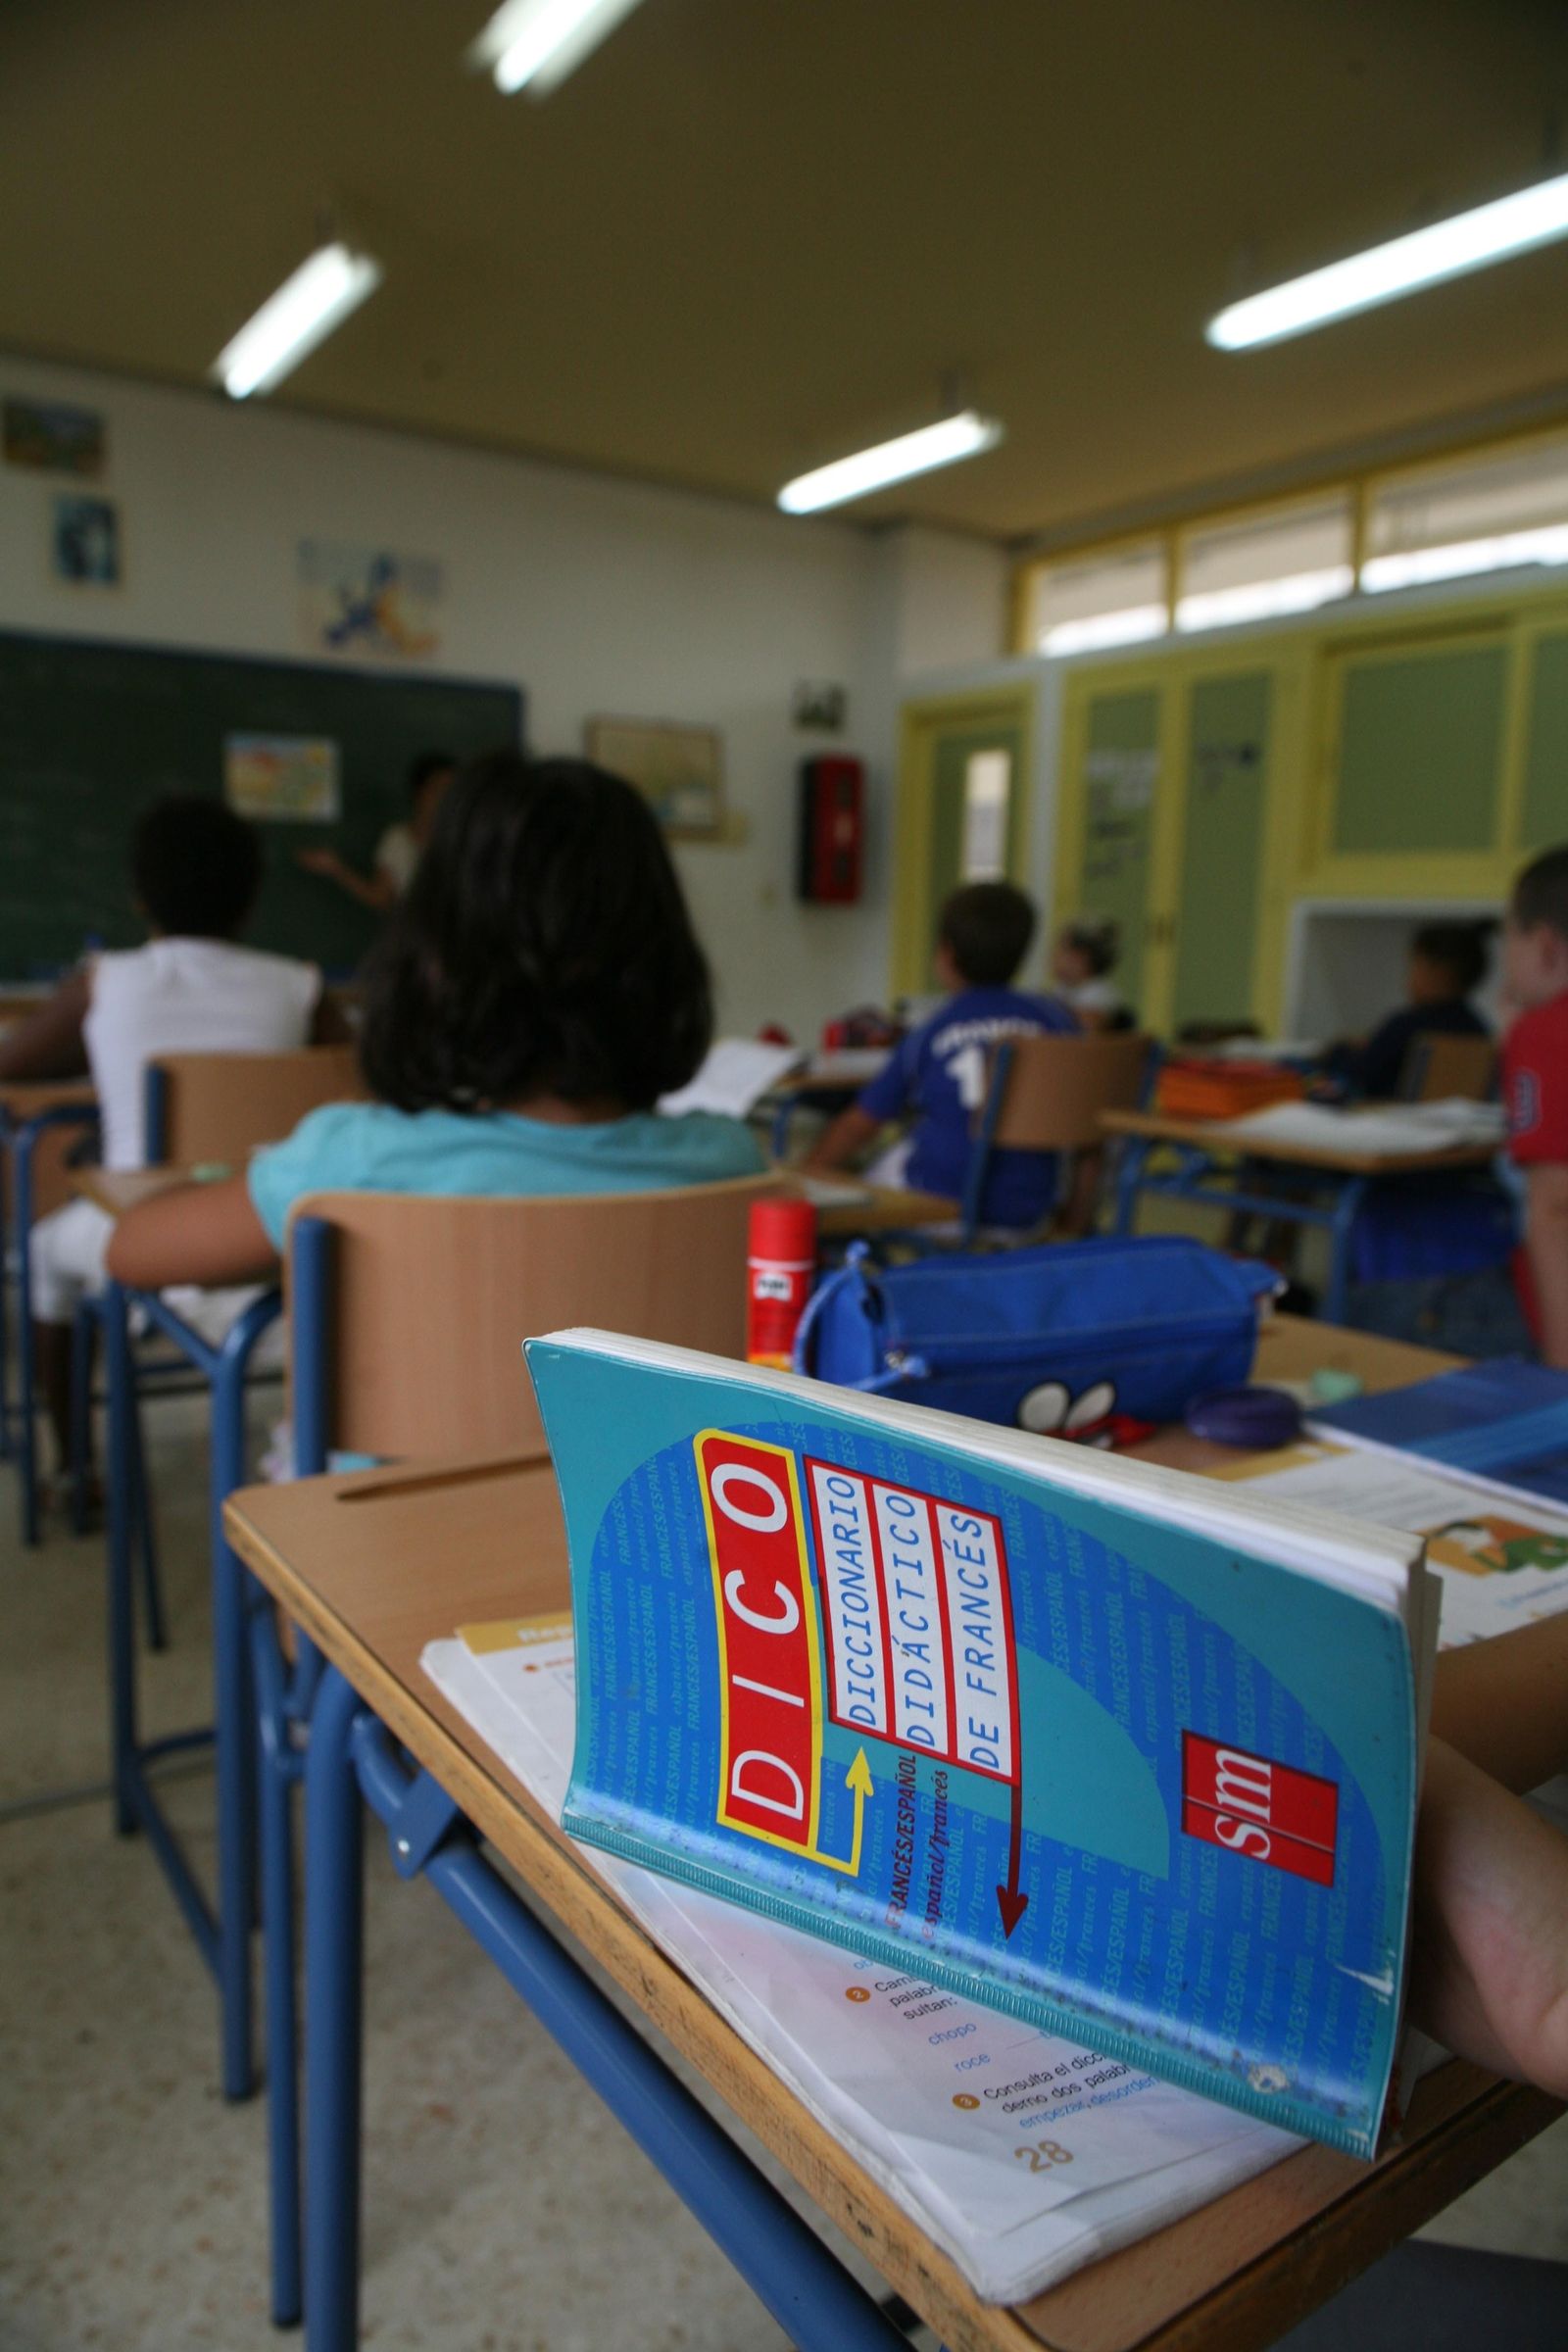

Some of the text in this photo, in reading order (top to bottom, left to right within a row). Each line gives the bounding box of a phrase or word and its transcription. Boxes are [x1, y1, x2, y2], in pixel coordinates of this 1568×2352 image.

[709, 1462, 806, 1823] DICO
[826, 1475, 878, 1727] DICCIONARIO
[884, 1494, 937, 1749] DIDÁCTICO
[948, 1513, 1003, 1772] DE FRANCÉS
[883, 1754, 917, 1929] FRANCÉS/ESPAÑOL
[921, 1769, 951, 1941] español/francés
[1212, 1747, 1273, 1861] sm
[903, 1997, 958, 2021] sultan:
[927, 2021, 977, 2047] chopo
[953, 2052, 992, 2074] roce
[983, 2070, 1054, 2101] Consulta
[1054, 2060, 1072, 2079] el
[1002, 2092, 1048, 2115] derno
[1051, 2080, 1082, 2101] dos
[1014, 2139, 1075, 2173] 28
